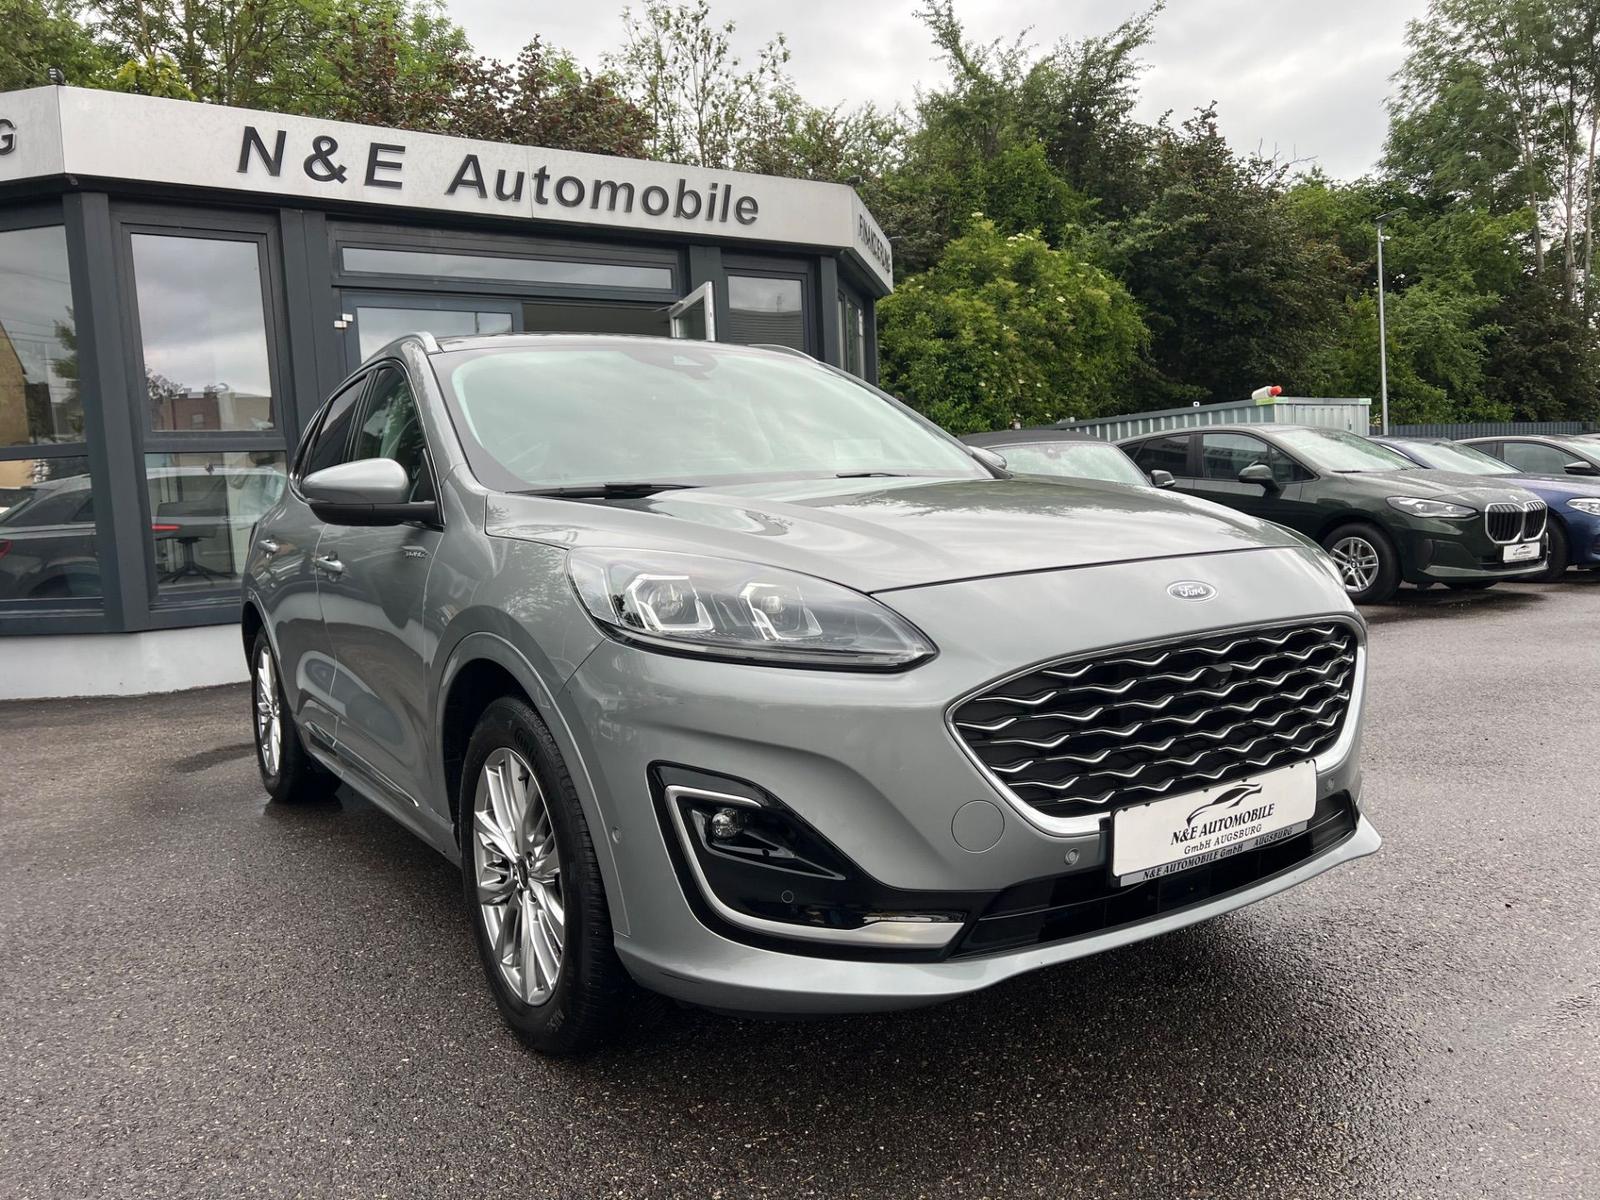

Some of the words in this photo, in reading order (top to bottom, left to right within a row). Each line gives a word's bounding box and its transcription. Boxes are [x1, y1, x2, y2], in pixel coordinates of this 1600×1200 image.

[444, 153, 760, 226] Automobile
[1178, 584, 1207, 597] Ford
[1171, 825, 1198, 845] N&E
[1199, 803, 1275, 840] AUTOMOBILE
[1184, 839, 1212, 855] GmbH
[1214, 823, 1262, 846] AUGSBURG
[1142, 868, 1162, 880] N&E
[1163, 851, 1219, 875] AUTOMOBILE
[1219, 843, 1244, 858] GmbH
[1253, 827, 1293, 848] AUGSBURG
